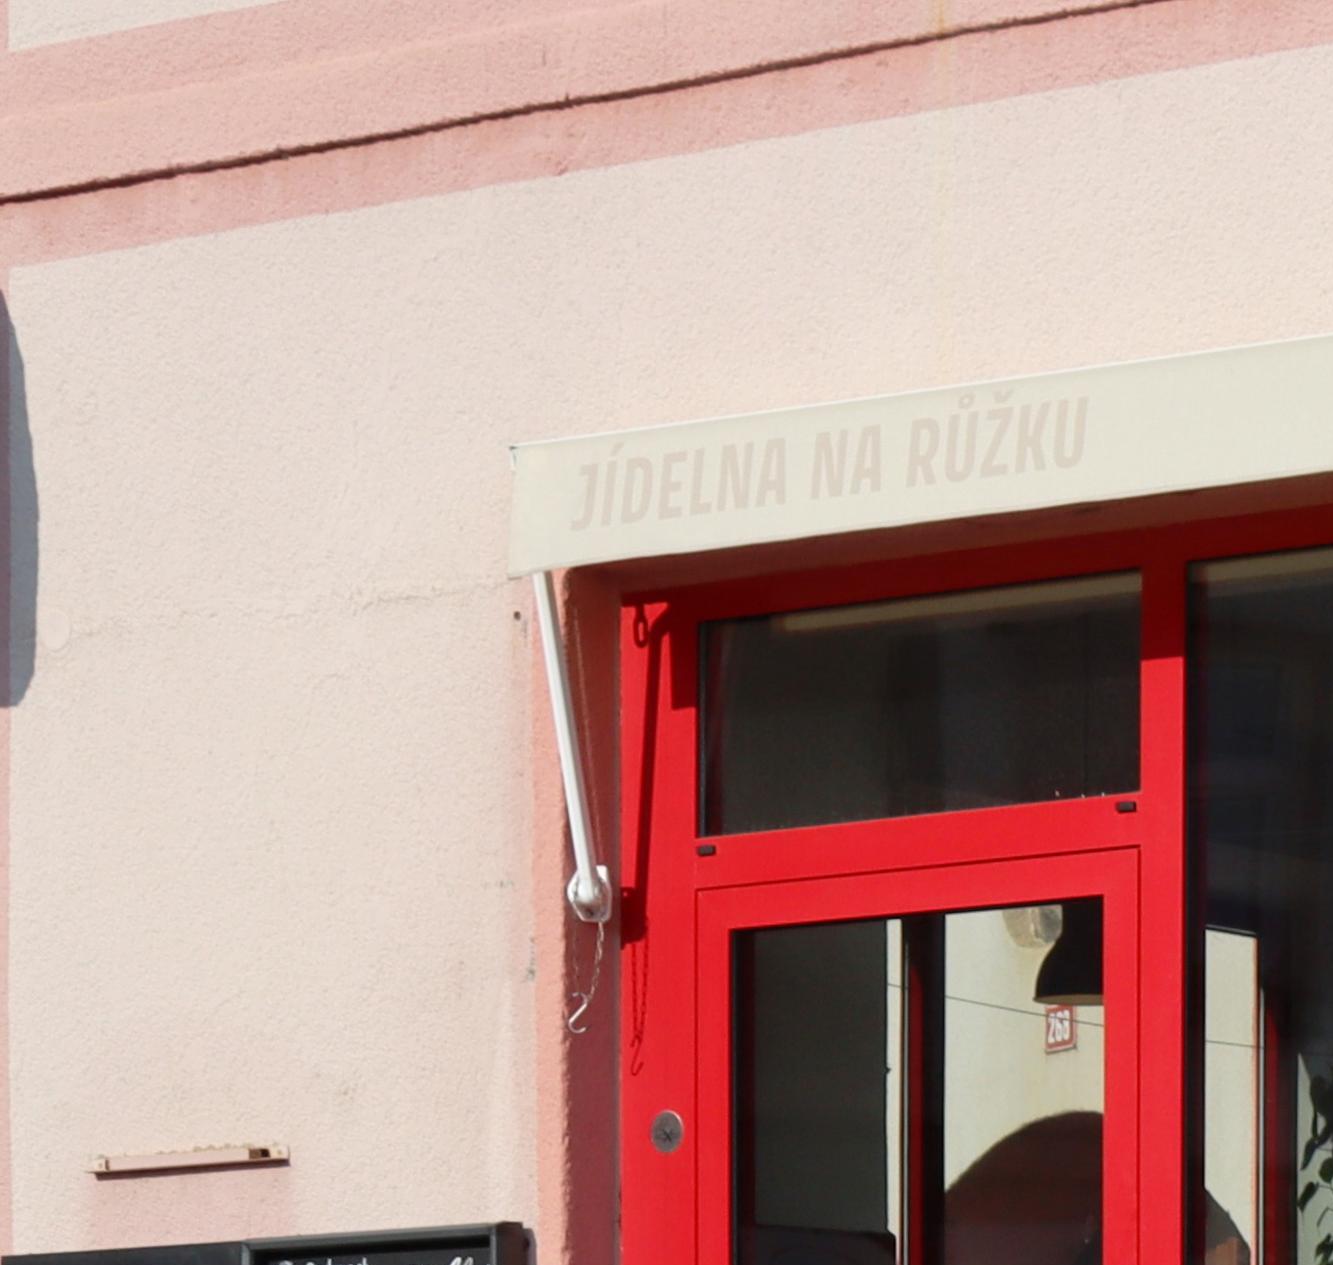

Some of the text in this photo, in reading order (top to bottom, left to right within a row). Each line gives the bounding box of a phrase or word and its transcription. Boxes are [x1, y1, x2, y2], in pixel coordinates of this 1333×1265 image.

[570, 389, 1089, 531] JÍDELNA NA RŮŽKU
